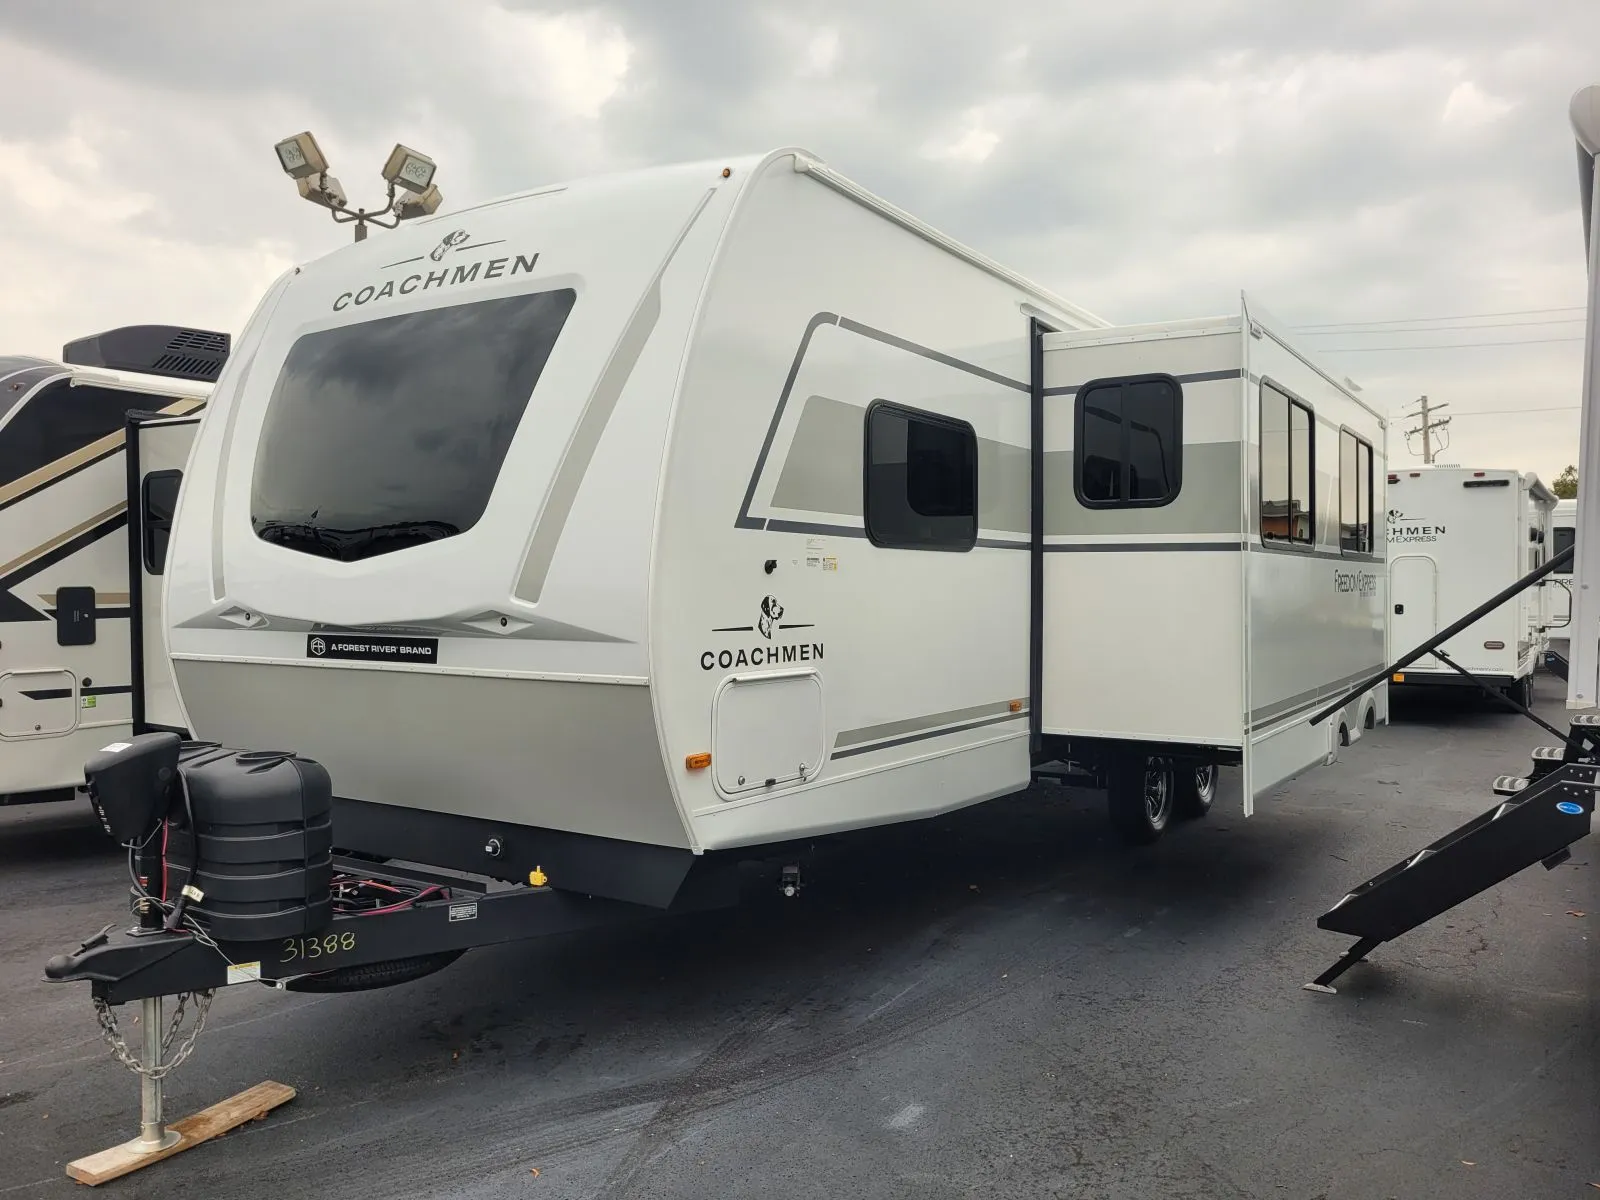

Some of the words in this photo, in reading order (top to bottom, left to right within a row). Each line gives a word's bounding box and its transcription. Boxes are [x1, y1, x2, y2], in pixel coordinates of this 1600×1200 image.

[332, 252, 540, 312] COACHMEN
[331, 643, 338, 651] A
[338, 644, 370, 652] FOREST
[371, 645, 398, 653] RIVER
[400, 646, 432, 655] BRAND
[700, 643, 824, 671] COACHMEN
[279, 932, 356, 963] 31388
